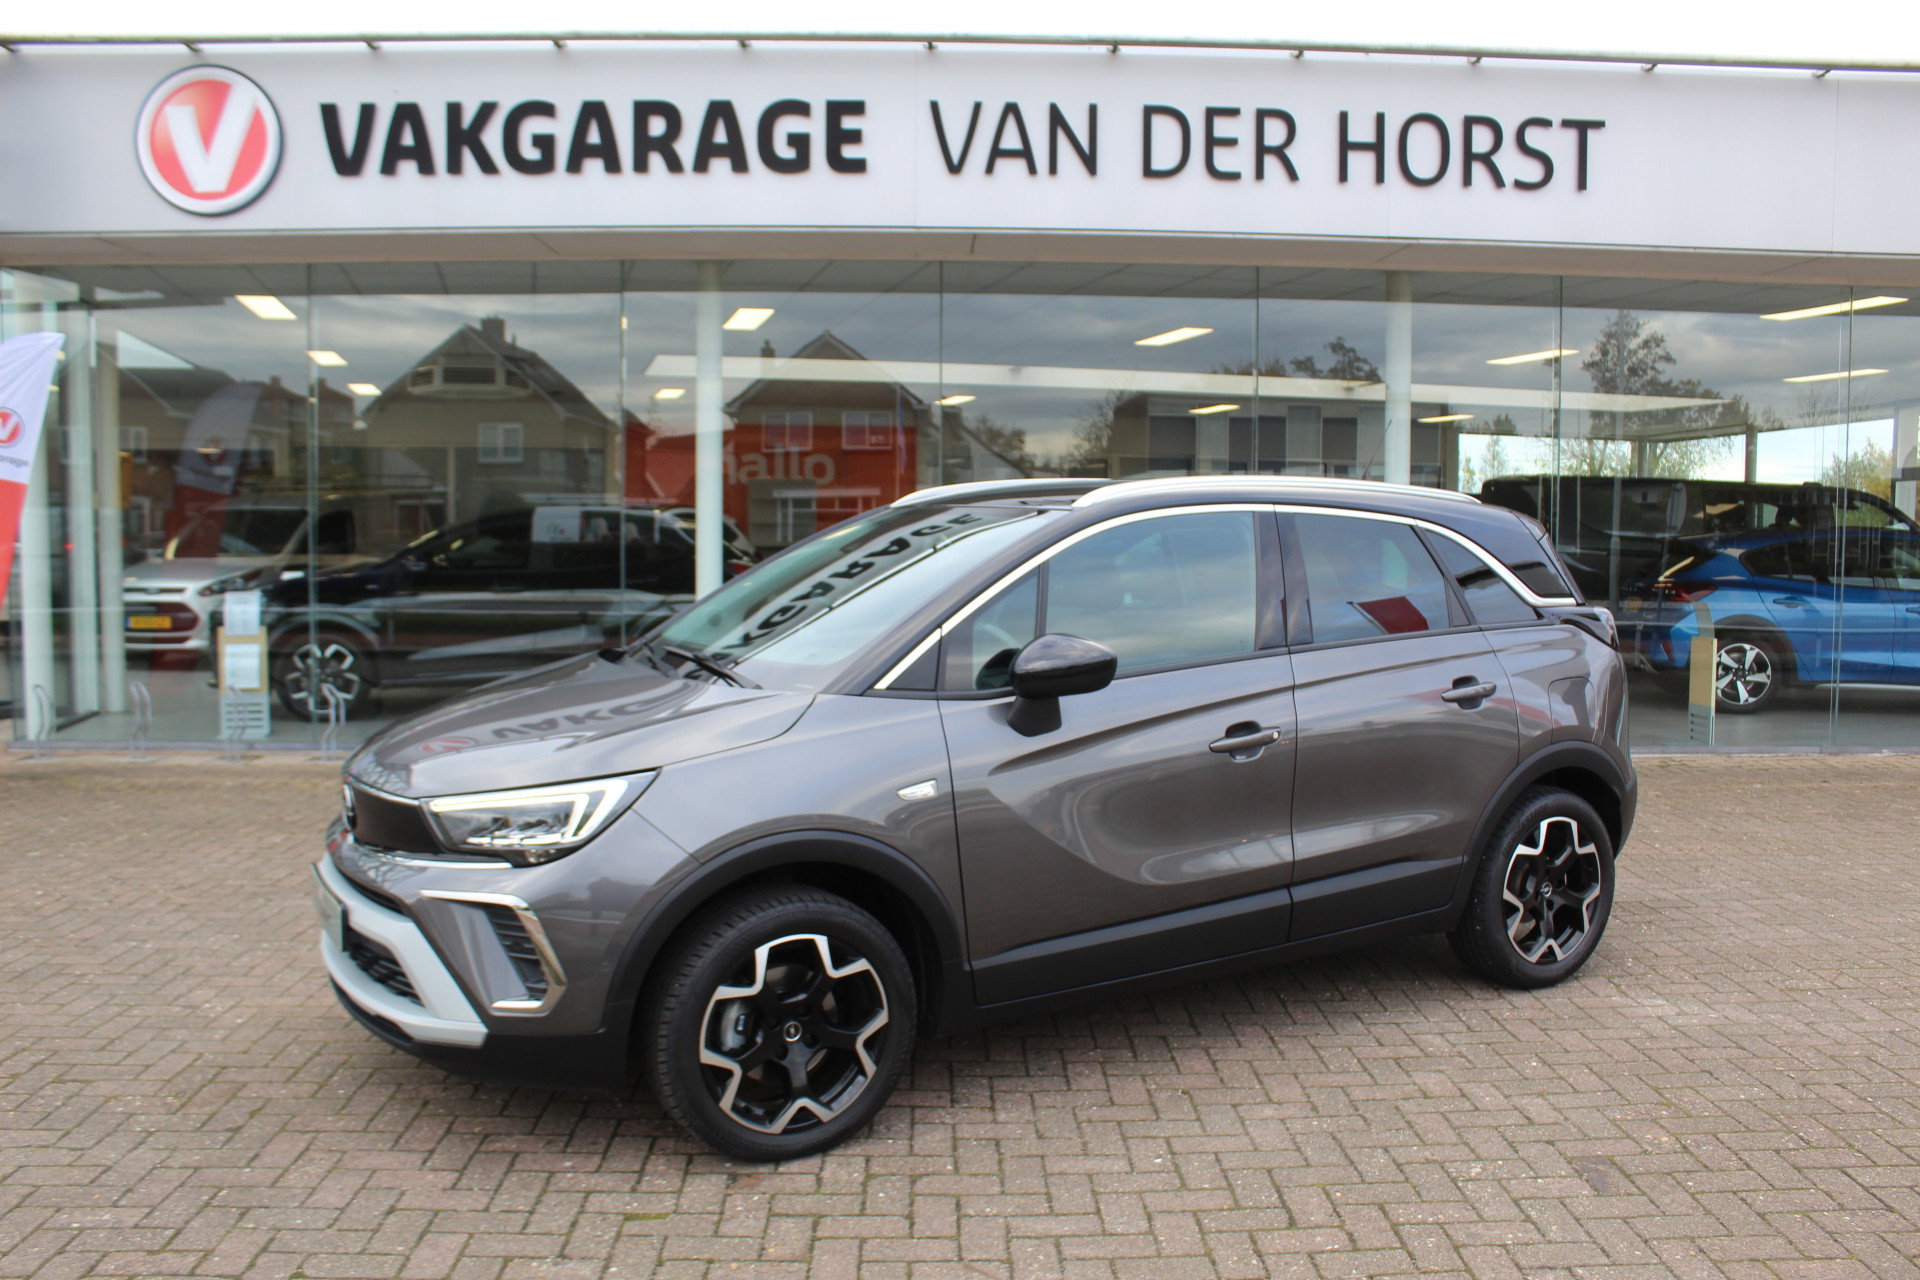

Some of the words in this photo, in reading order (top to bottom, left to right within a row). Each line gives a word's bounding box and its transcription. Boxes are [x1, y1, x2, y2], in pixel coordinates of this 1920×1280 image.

[319, 98, 867, 178] VAKGARAGE
[929, 100, 1098, 177] VAN
[1142, 103, 1300, 182] DER
[1338, 109, 1606, 192] HORST
